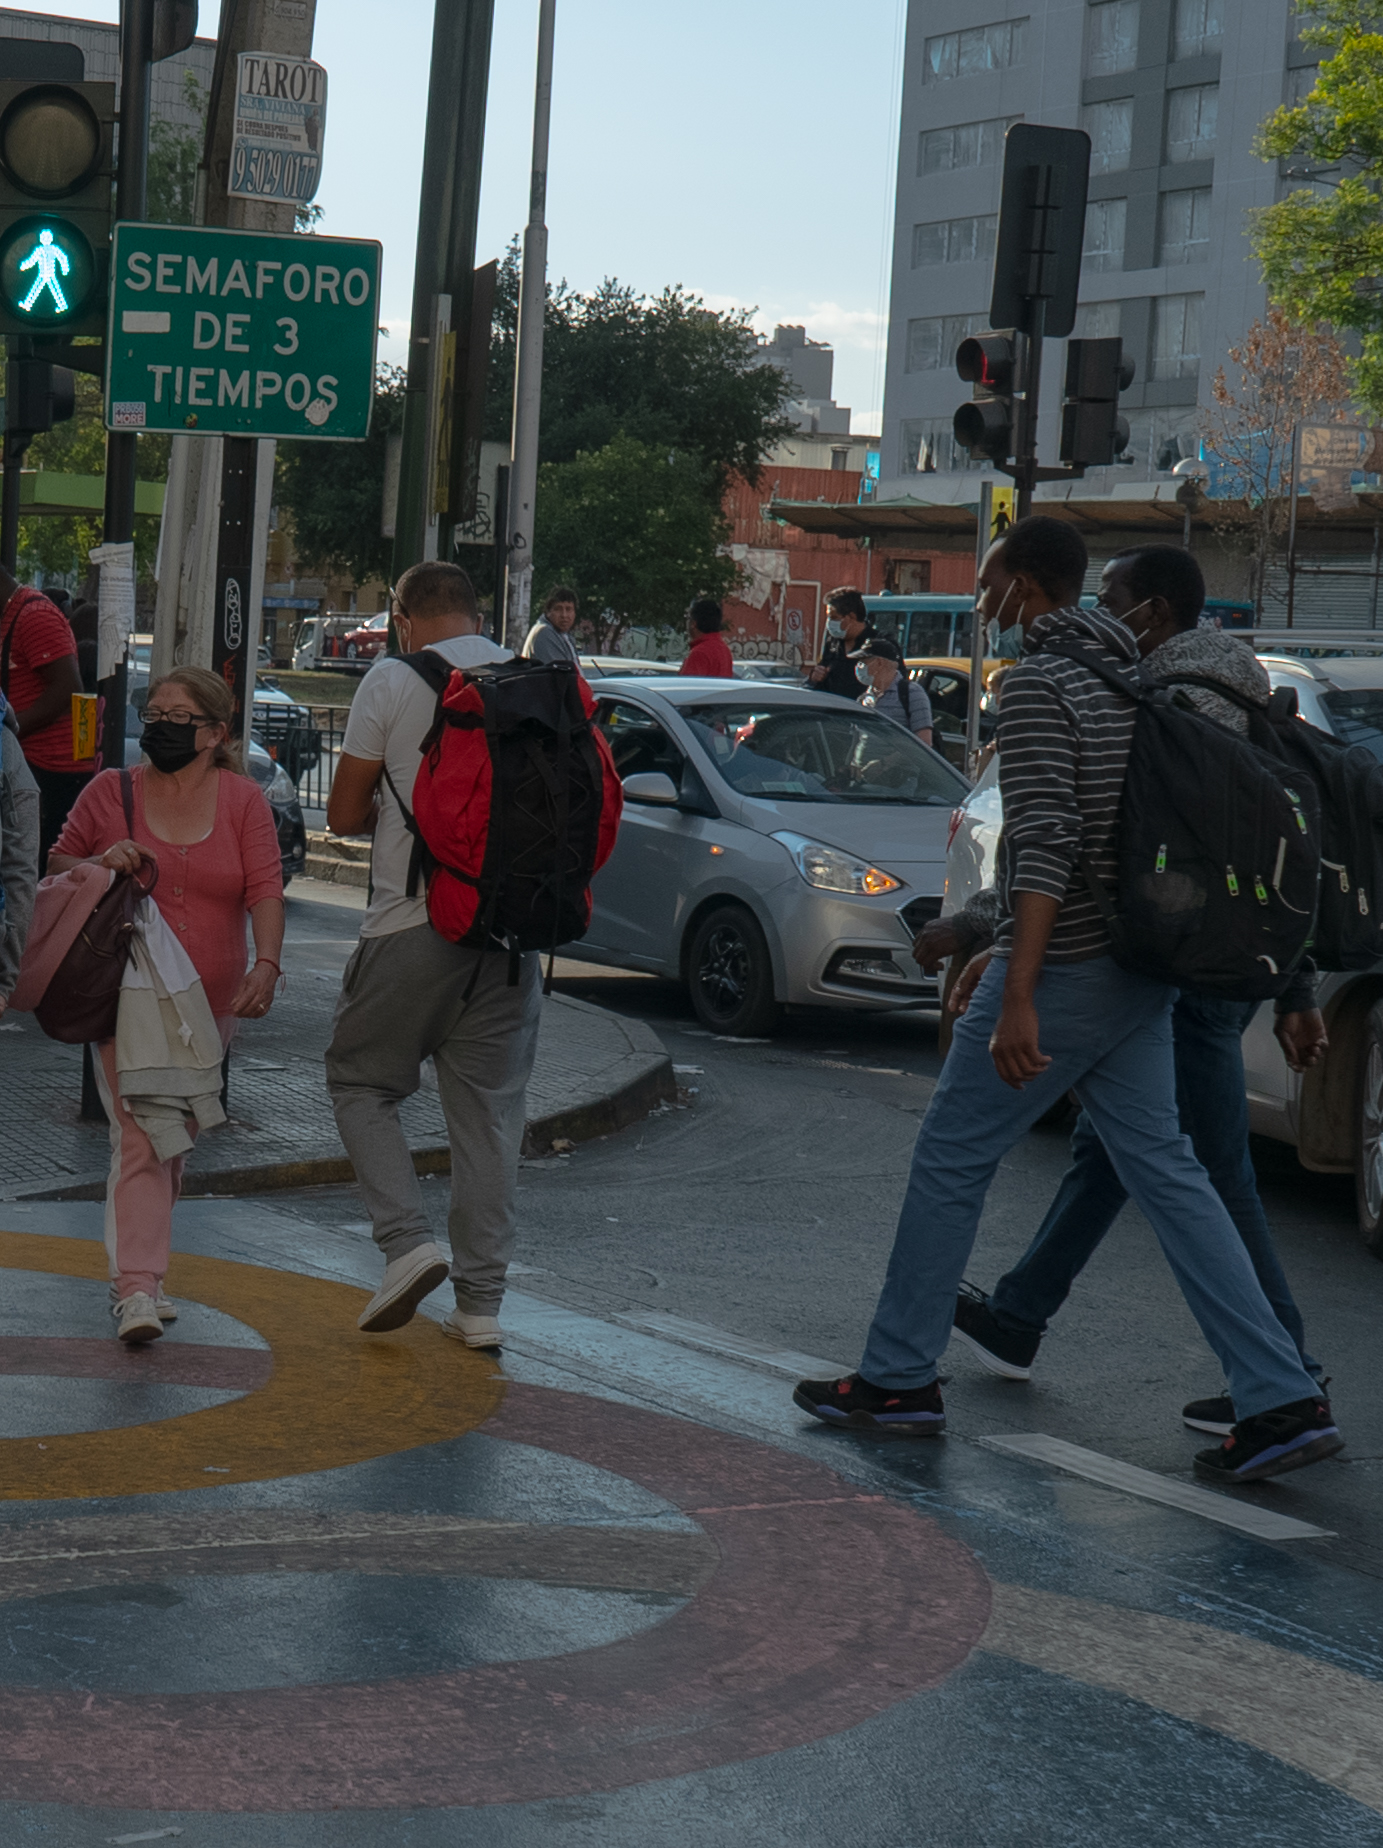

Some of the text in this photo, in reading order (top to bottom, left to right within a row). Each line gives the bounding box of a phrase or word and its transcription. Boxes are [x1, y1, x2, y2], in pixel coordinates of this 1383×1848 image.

[244, 58, 321, 103] TAROT
[264, 99, 306, 115] VIVIANA
[233, 149, 319, 199] 9 5029 0177
[125, 251, 371, 306] SEMAFORO
[193, 311, 300, 356] DE 3
[147, 365, 339, 414] TIEMPOS
[115, 413, 144, 425] MORE
